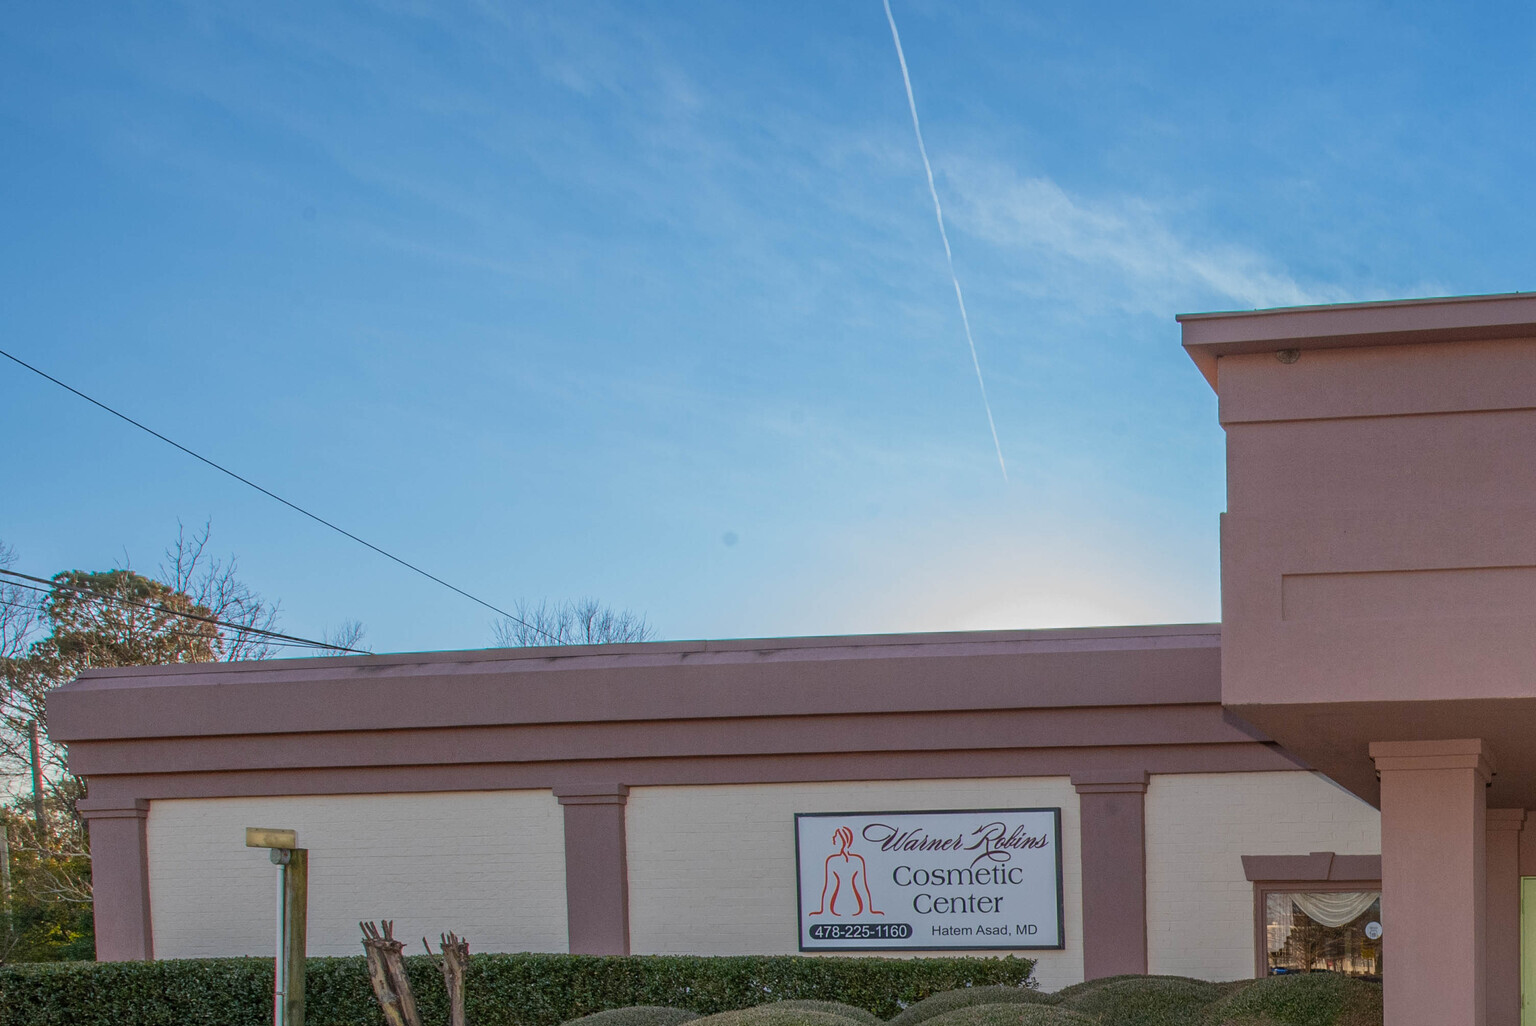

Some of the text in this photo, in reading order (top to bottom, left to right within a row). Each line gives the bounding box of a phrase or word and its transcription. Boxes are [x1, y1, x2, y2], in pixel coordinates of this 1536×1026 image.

[862, 822, 1049, 868] Warner Robins
[893, 864, 1023, 886] Cosmetic
[913, 894, 1003, 914] Center
[814, 925, 907, 938] 478-225-1160
[931, 925, 1038, 937] Hatem Asad, MD
